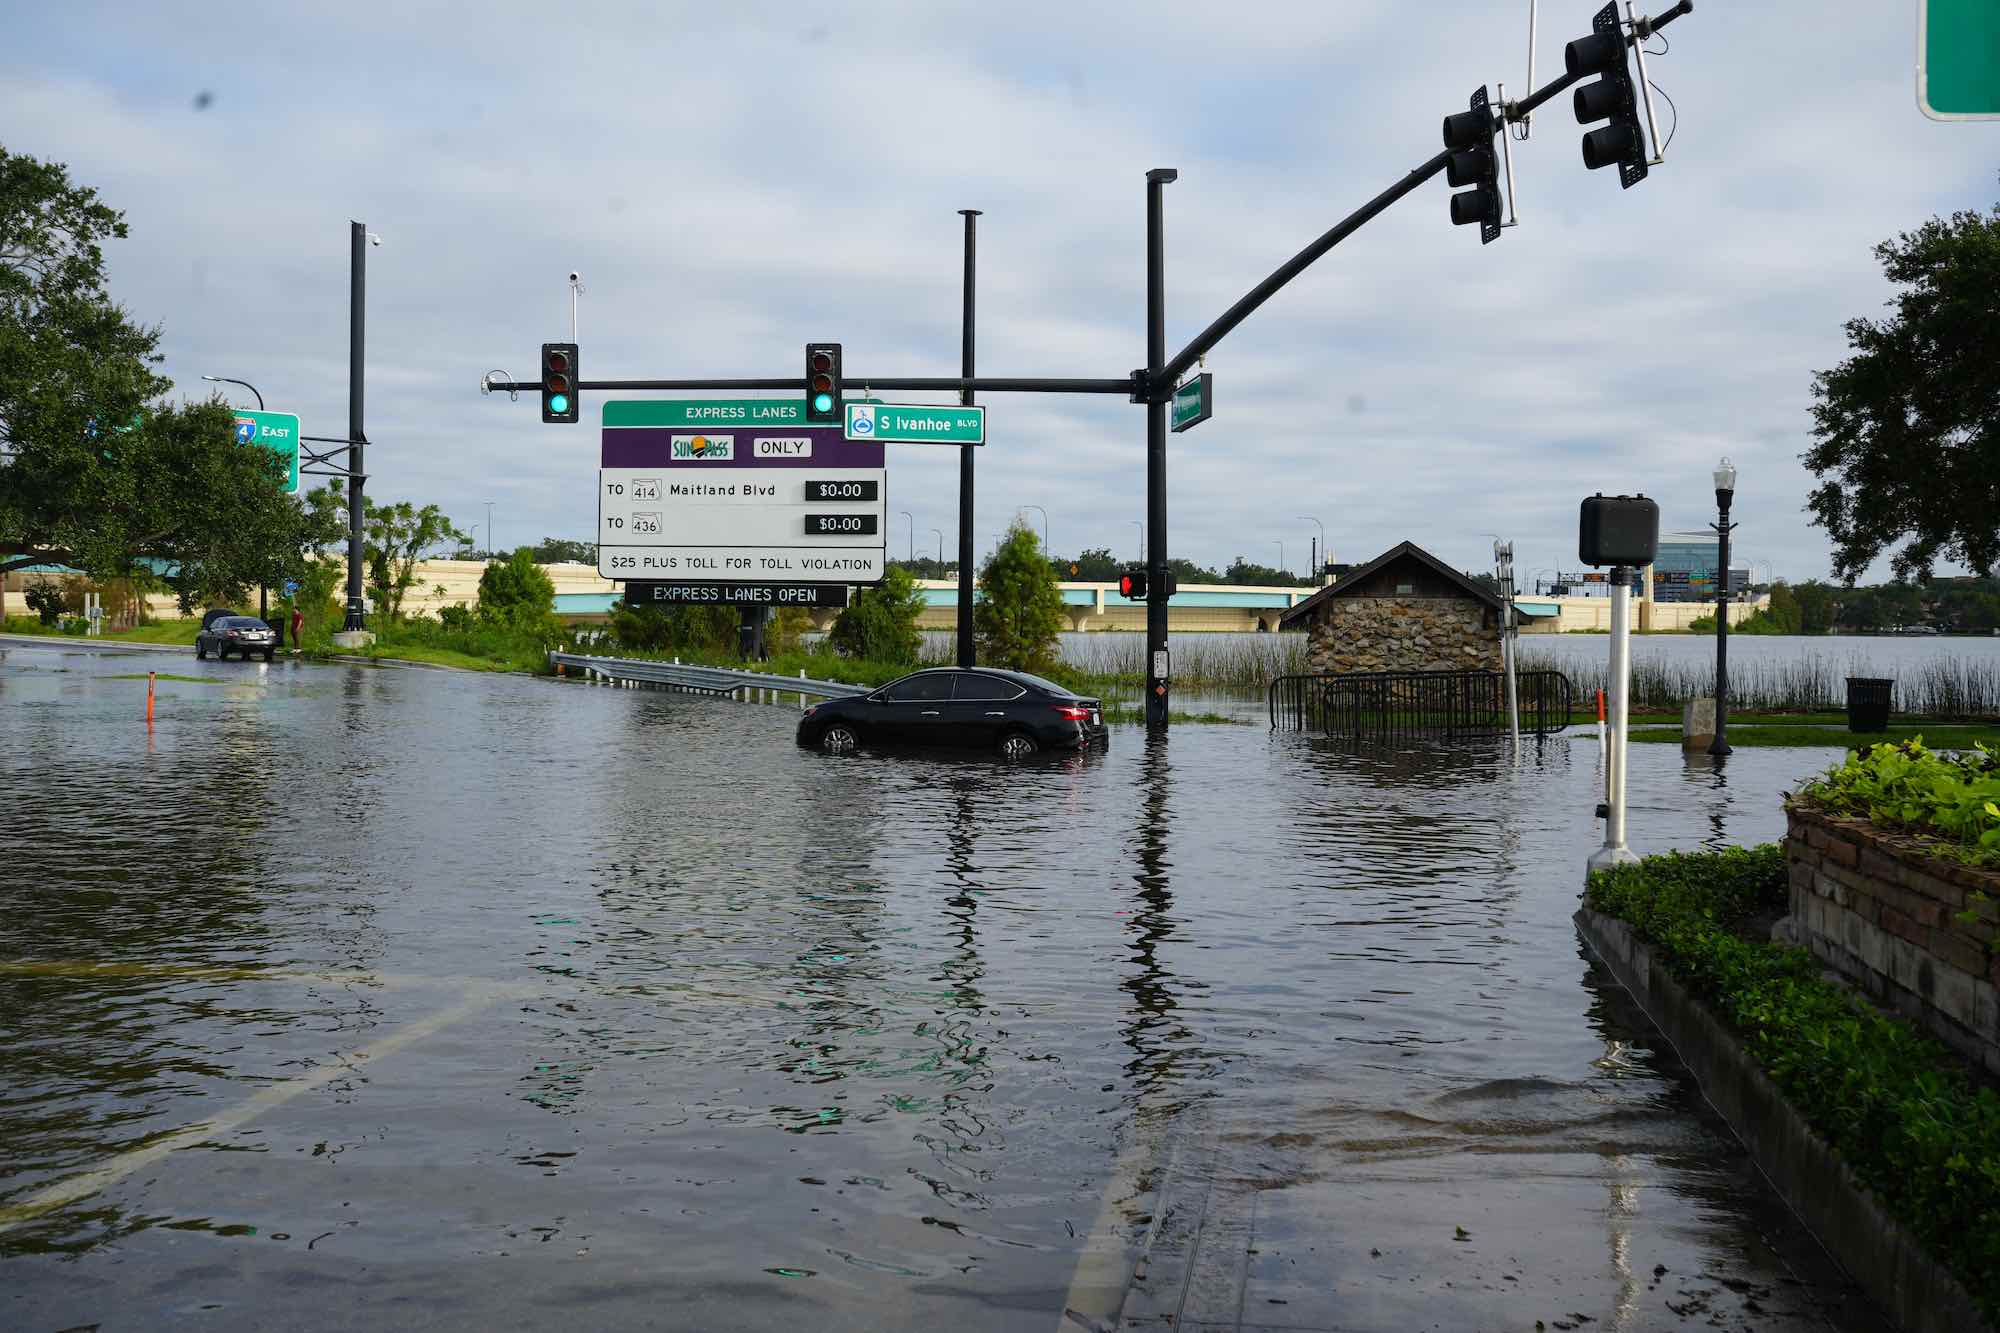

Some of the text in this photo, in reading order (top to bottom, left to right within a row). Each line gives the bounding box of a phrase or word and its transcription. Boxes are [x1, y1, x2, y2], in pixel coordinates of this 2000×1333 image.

[686, 407, 797, 418] EXPRESS LANES
[880, 416, 978, 431] S Ivanhoe BLVD
[239, 425, 248, 436] 4
[761, 441, 804, 454] ONLY
[607, 484, 775, 498] TO 414 Maitland Blvd
[819, 484, 862, 497] $0.00
[607, 518, 657, 532] TO 436
[819, 518, 861, 530] $0.00
[611, 556, 872, 570] $25 PLUS TOLL FOR TOLL VIOLATION
[653, 587, 817, 602] EXPRESS LANES OPEN
